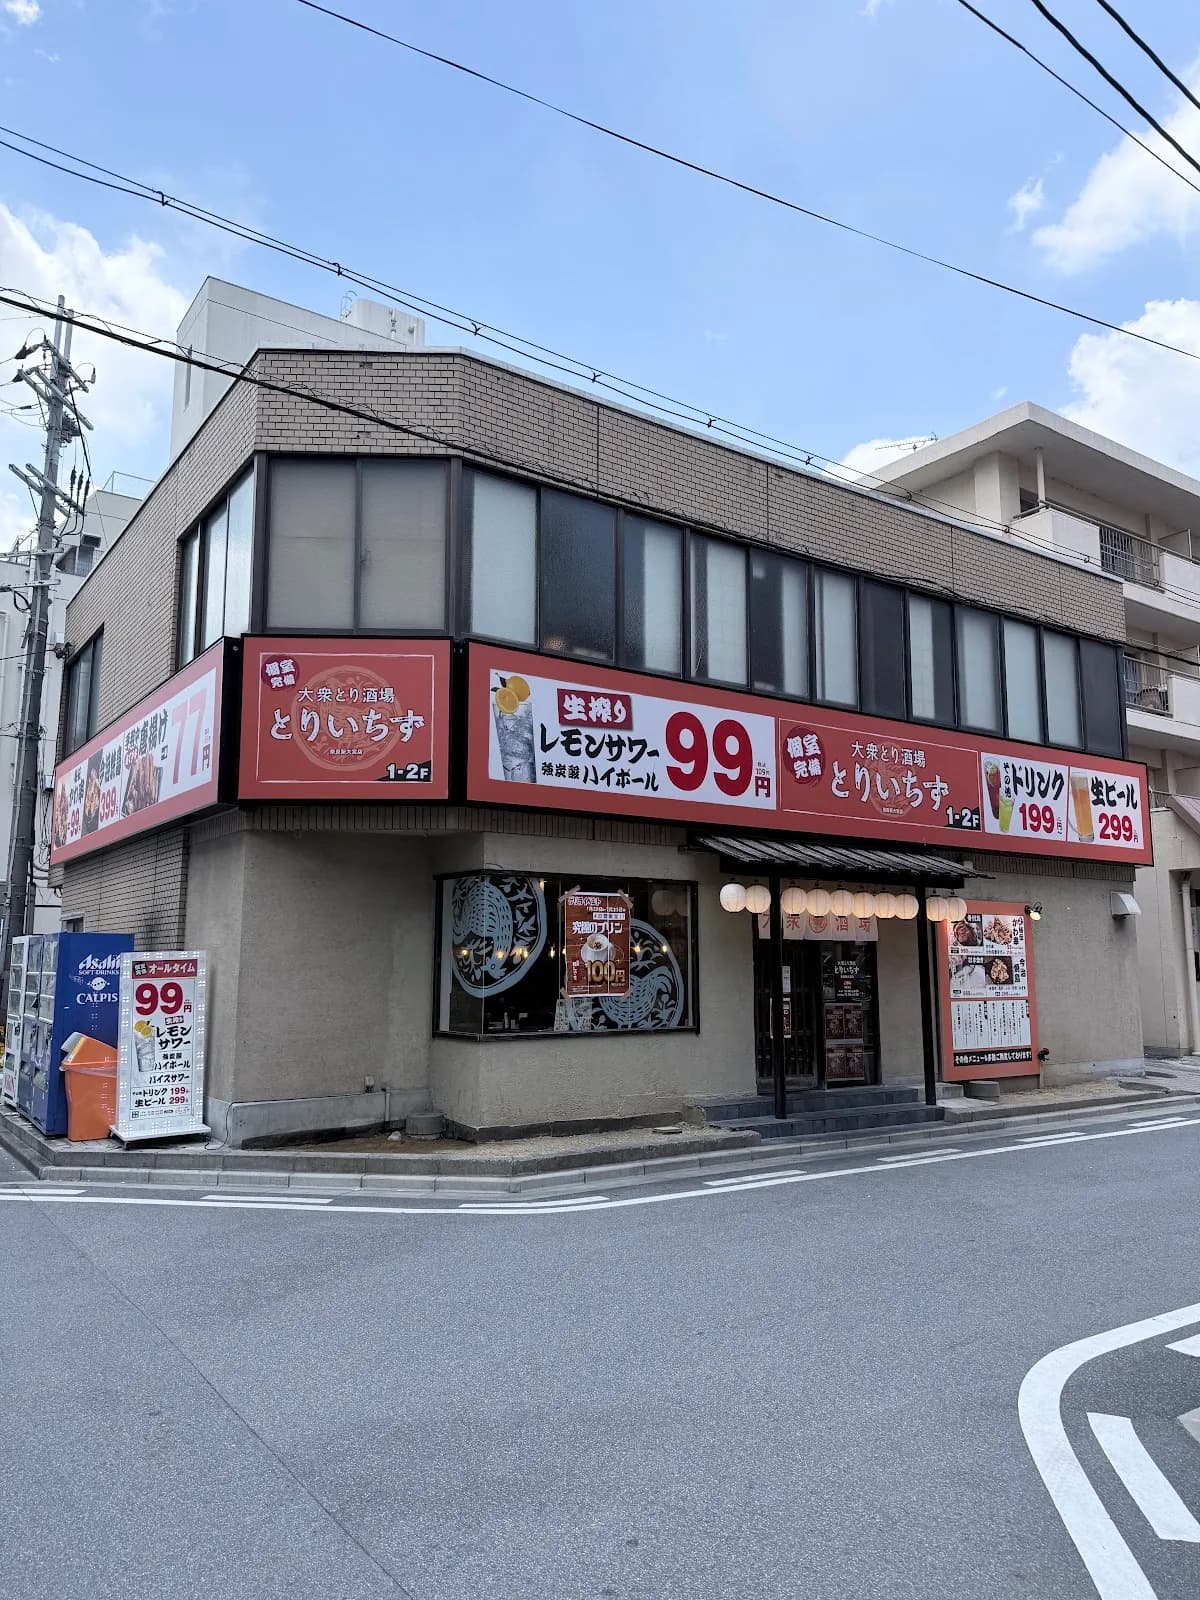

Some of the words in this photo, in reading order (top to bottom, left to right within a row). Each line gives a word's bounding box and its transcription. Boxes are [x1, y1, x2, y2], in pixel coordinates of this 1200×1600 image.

[265, 659, 296, 676] 個室
[270, 674, 296, 689] 完備
[298, 687, 395, 704] 大衆とり酒場
[562, 694, 629, 724] 生搾り
[270, 707, 426, 743] とりいちず
[540, 724, 660, 764] レモンサワー
[786, 733, 821, 759] 個室
[851, 741, 927, 768] 大衆とり酒場
[793, 758, 822, 779] 完備
[831, 760, 949, 811] とりいちず
[1011, 763, 1065, 801] ドリンク
[1090, 776, 1138, 810] 生ビール
[148, 961, 196, 974] オールタイム
[76, 992, 119, 1005] CALPIS
[156, 1025, 192, 1038] レモン
[158, 1038, 191, 1050] サワー
[154, 1060, 191, 1072] ハイボール
[134, 1097, 166, 1108] 生ビール
